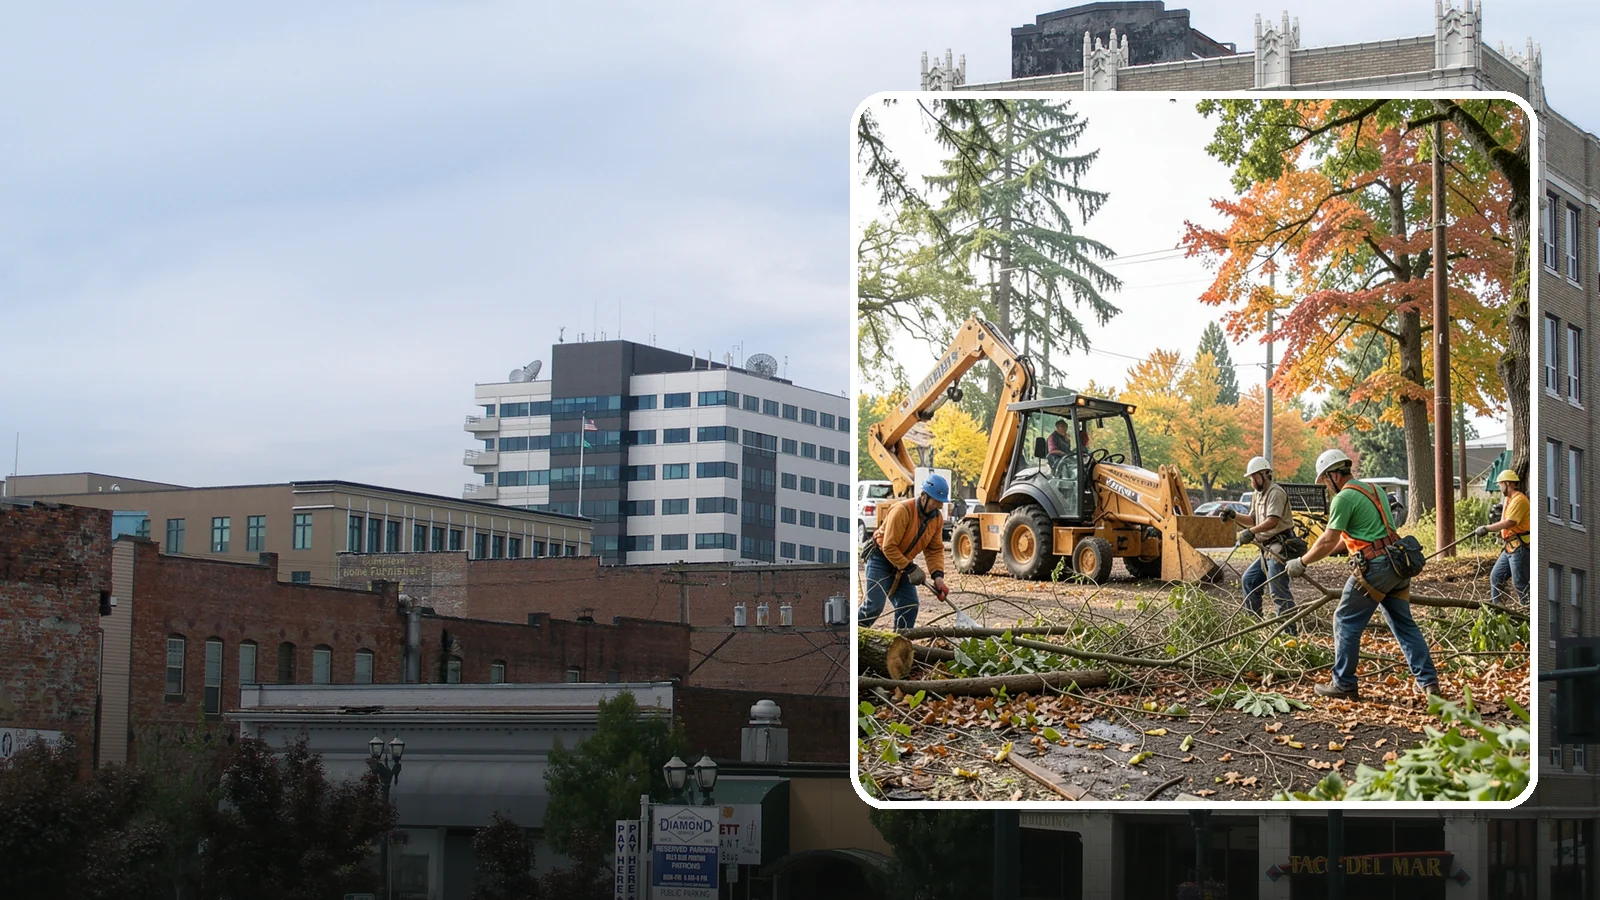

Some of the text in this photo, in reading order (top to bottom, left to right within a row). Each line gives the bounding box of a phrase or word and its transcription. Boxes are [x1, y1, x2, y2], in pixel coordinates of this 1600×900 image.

[343, 566, 427, 577] Home Furnishers
[660, 818, 713, 832] DIAMOND
[1022, 815, 1069, 828] BUILDING
[656, 845, 716, 854] RESERVED PARKING
[616, 825, 625, 893] PAY HERE
[627, 825, 637, 893] PAY HERE
[722, 851, 739, 862] Soup
[671, 862, 701, 870] PATRONS
[1346, 857, 1384, 876] DEL
[1392, 857, 1442, 877] MAR
[660, 889, 710, 898] PUBLIC PARKING
